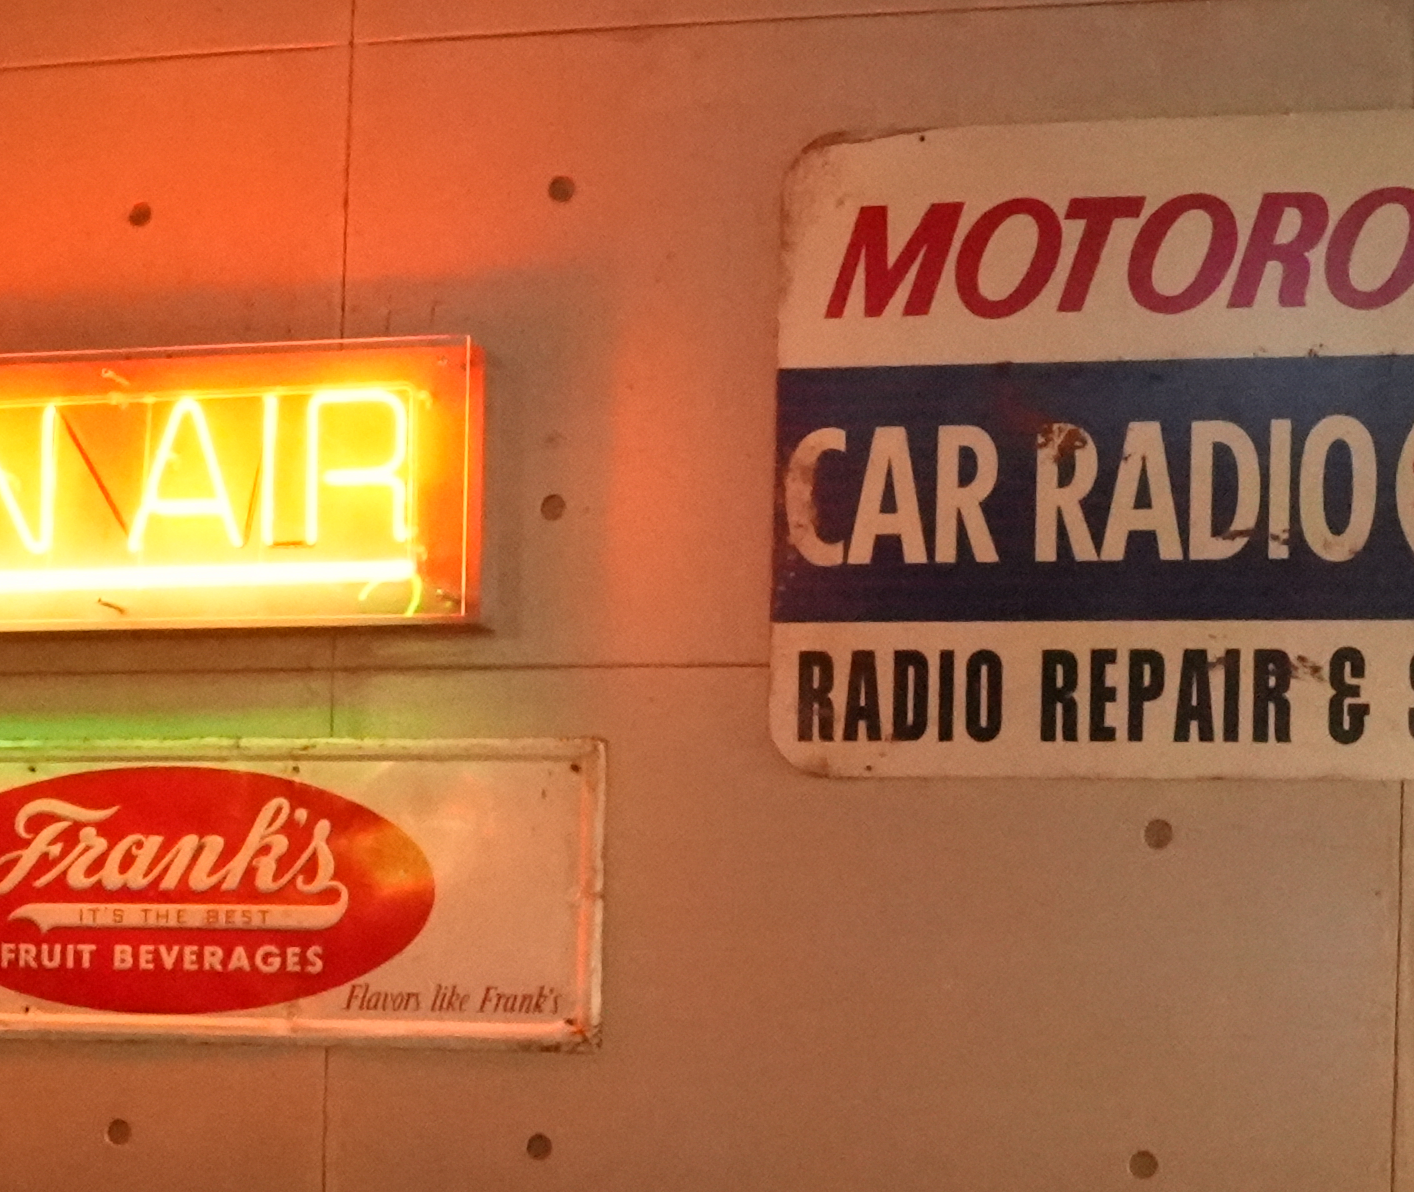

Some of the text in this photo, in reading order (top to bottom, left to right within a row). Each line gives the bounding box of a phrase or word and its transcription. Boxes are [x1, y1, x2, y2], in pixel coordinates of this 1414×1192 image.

[129, 390, 411, 550] AIR
[786, 414, 1378, 566] CAR RADIO
[796, 649, 1003, 742] RADIO
[1040, 649, 1291, 742] REPAIR
[1329, 648, 1370, 743] &
[78, 907, 270, 925] IT'S THE BEST
[0, 942, 324, 974] FRUIT BEVERAGES
[343, 983, 563, 1016] Flavors like Frank's
